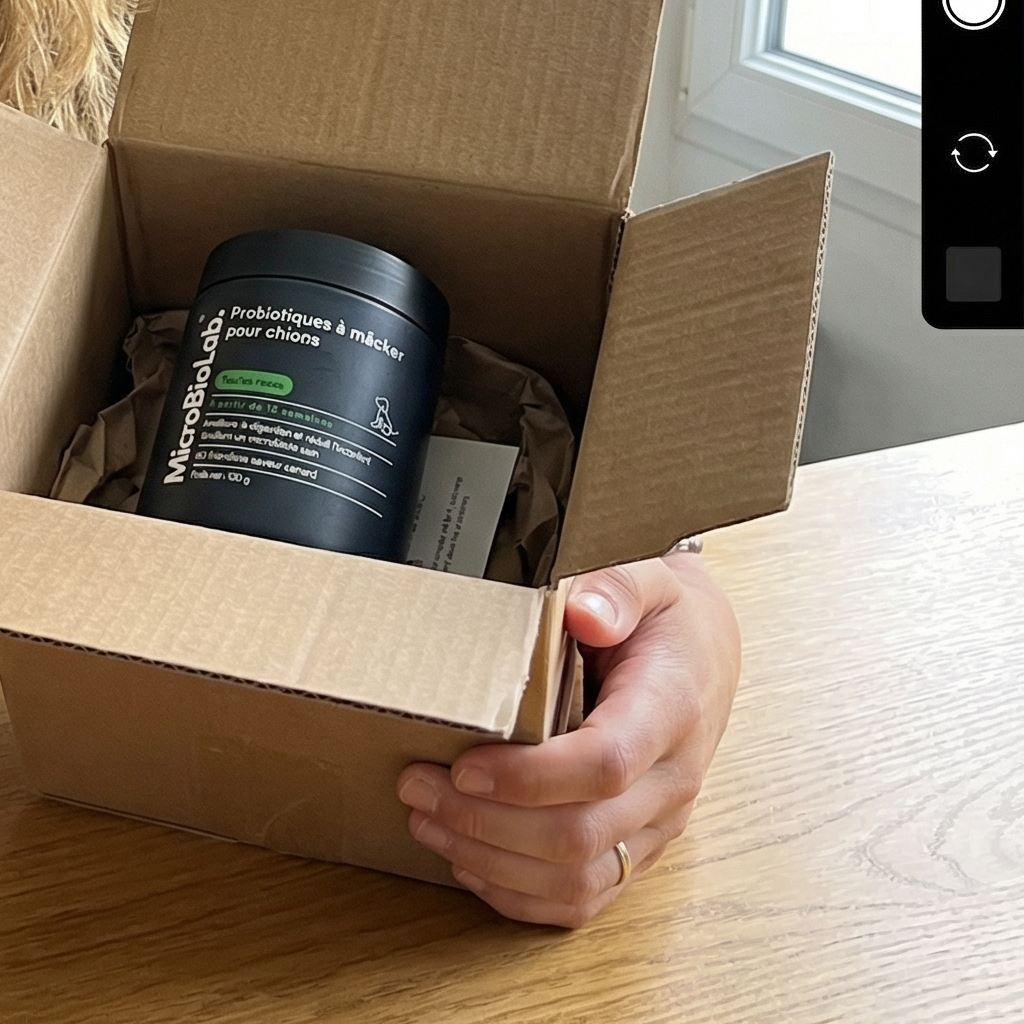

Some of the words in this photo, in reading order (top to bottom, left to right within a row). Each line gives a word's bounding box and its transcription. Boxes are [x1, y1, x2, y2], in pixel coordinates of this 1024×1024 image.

[230, 305, 332, 332] Probiotiques
[335, 319, 346, 336] à
[225, 326, 262, 341] pour
